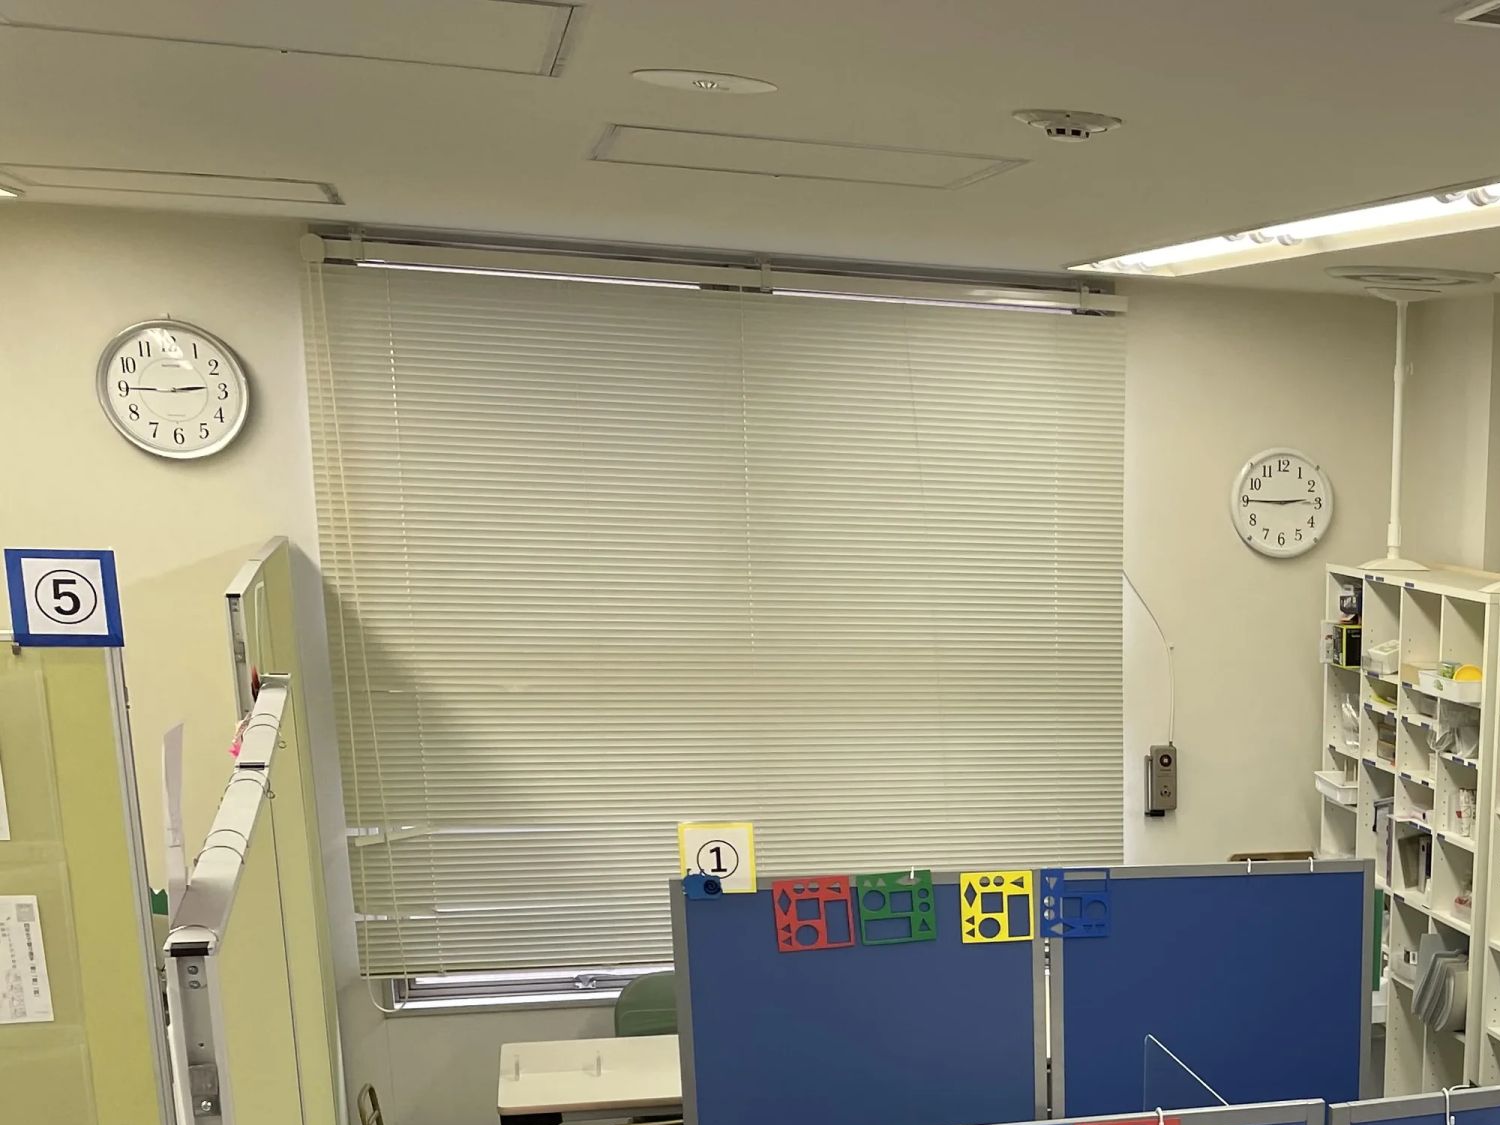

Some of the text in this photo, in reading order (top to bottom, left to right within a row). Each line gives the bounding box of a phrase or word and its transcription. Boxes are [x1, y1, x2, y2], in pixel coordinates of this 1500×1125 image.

[138, 341, 151, 357] 11
[192, 343, 198, 359] 1
[120, 357, 136, 373] 10
[208, 359, 219, 376] 2
[117, 380, 129, 397] 9
[217, 382, 229, 400] 3
[128, 403, 140, 421] 8
[213, 406, 225, 423] 4
[149, 422, 159, 438] 7
[173, 428, 185, 445] 6
[199, 423, 209, 439] 5
[1262, 465, 1272, 478] 11
[1277, 459, 1290, 472] 12
[1297, 466, 1302, 479] 1
[1250, 478, 1261, 491] 10
[1307, 479, 1316, 493] 2
[1242, 494, 1250, 507] 9
[1313, 496, 1322, 510] 3
[1249, 513, 1257, 526] 8
[1307, 515, 1315, 528] 4
[1262, 528, 1270, 540] 7
[1277, 532, 1285, 546] 6
[1294, 528, 1302, 541] 5
